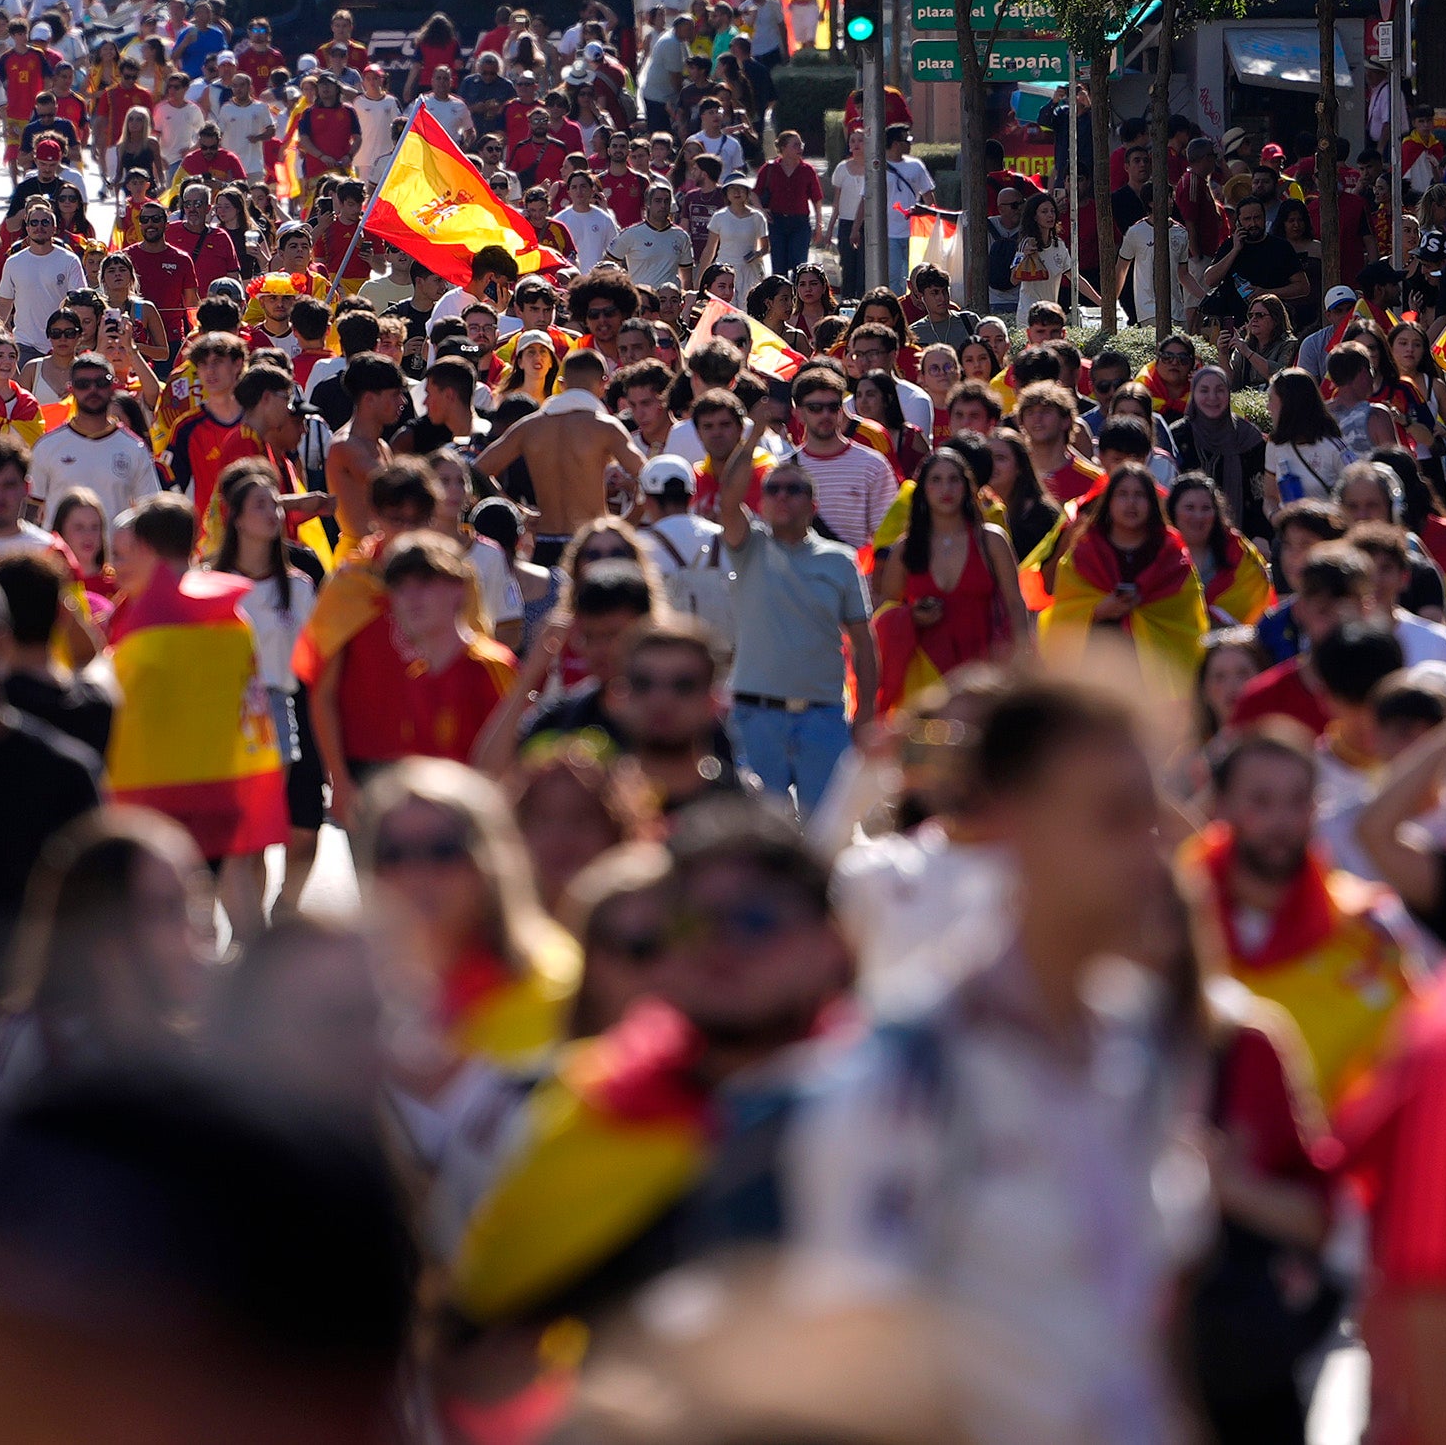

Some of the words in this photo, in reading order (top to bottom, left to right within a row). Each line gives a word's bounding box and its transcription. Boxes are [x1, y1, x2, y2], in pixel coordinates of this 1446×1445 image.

[918, 7, 953, 20] plaza
[918, 59, 954, 72] plaza
[989, 53, 1061, 70] España
